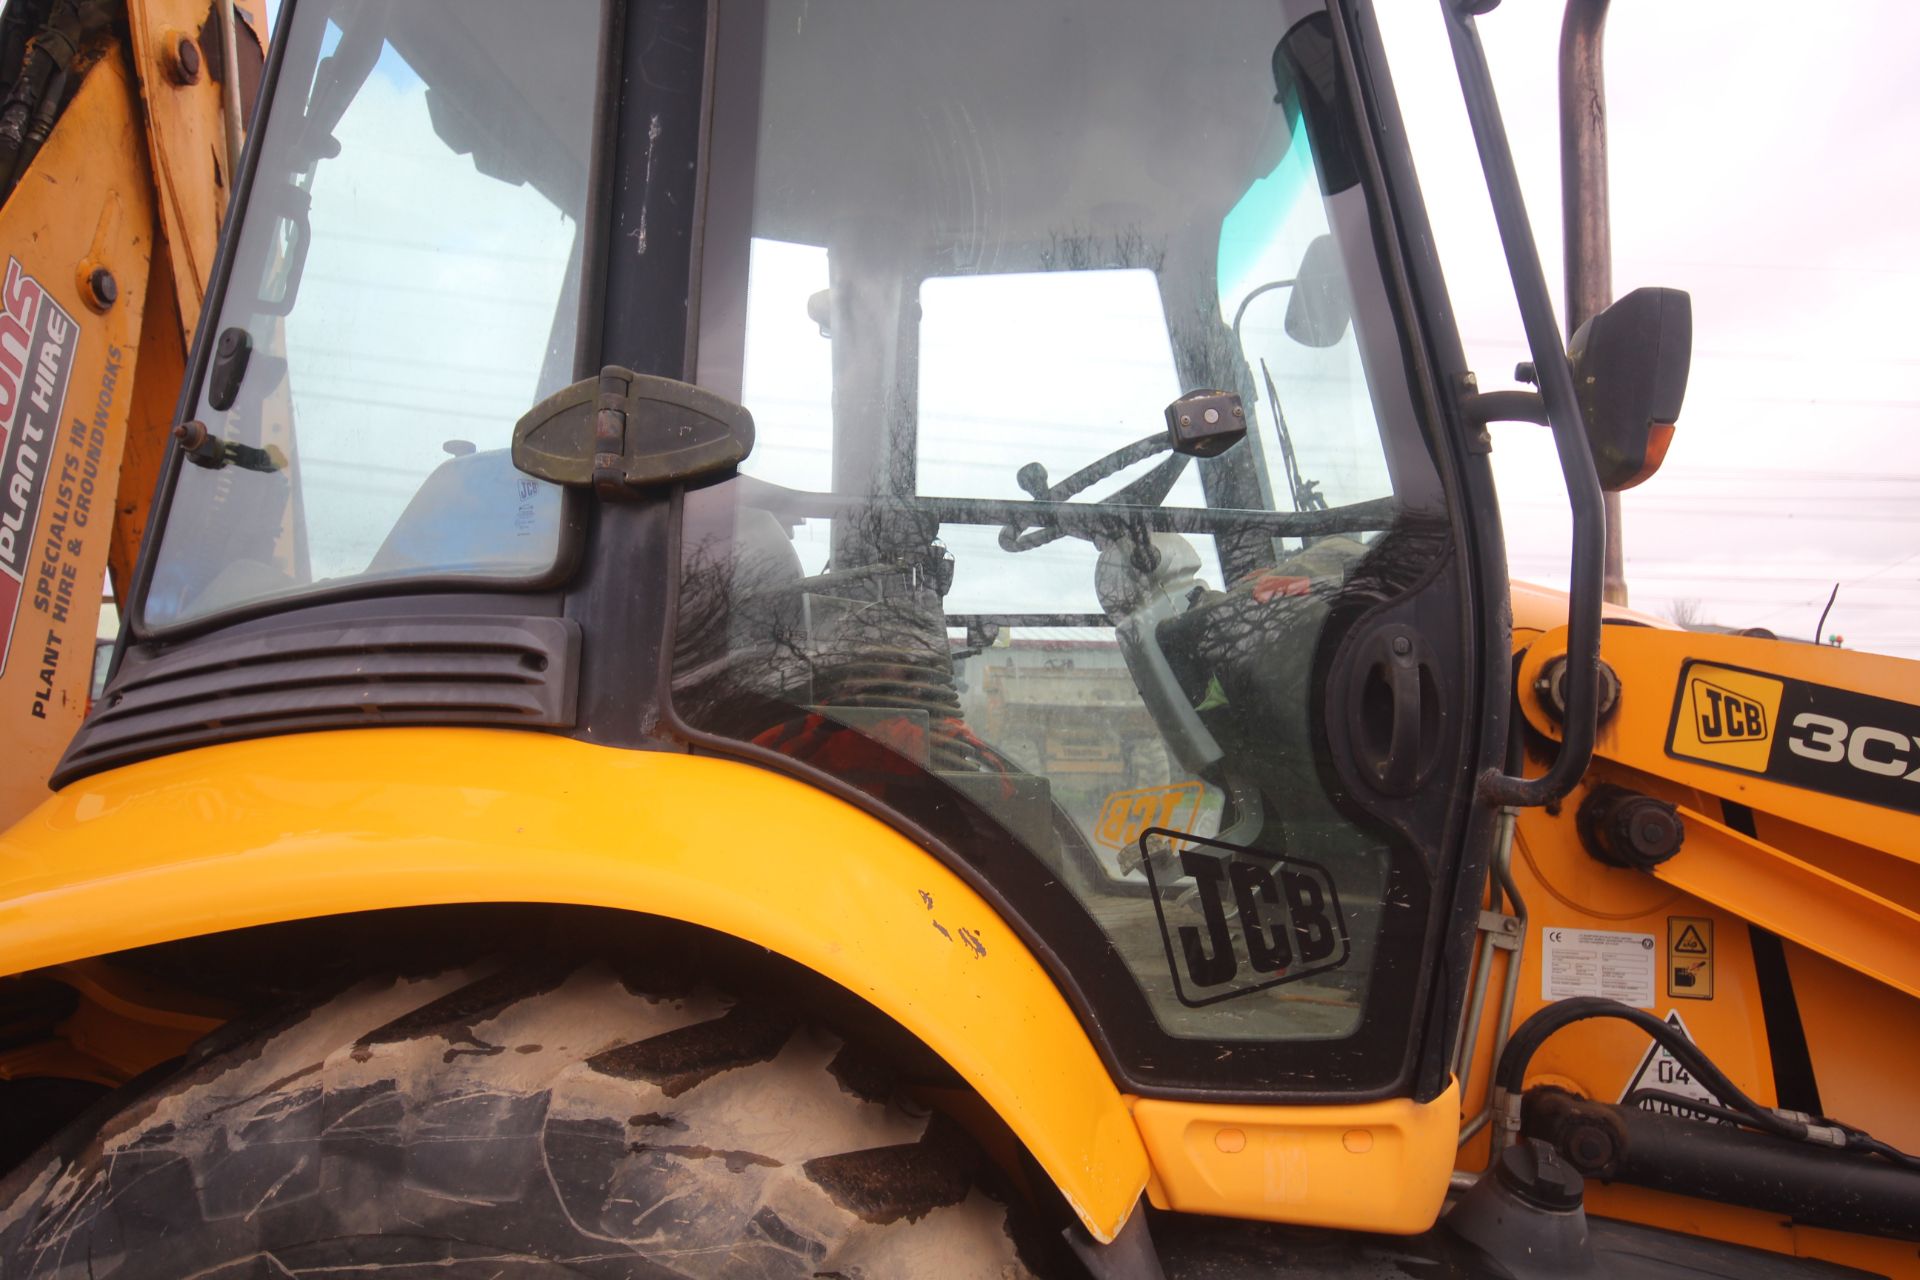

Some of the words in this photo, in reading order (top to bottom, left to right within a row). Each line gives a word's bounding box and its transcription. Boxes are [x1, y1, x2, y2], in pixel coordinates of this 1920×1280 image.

[0, 413, 44, 563] PLANT
[31, 307, 68, 414] HIRE
[73, 344, 122, 528] GROUNDWORKS
[34, 453, 80, 613] SPECIALISTS
[69, 418, 87, 449] IN
[520, 481, 539, 498] JCB
[67, 538, 83, 556] &
[52, 563, 77, 623] HIRE
[32, 629, 62, 719] PLANT
[1702, 688, 1762, 737] JCB
[1789, 712, 1920, 783] 3C
[1178, 850, 1335, 987] JCB
